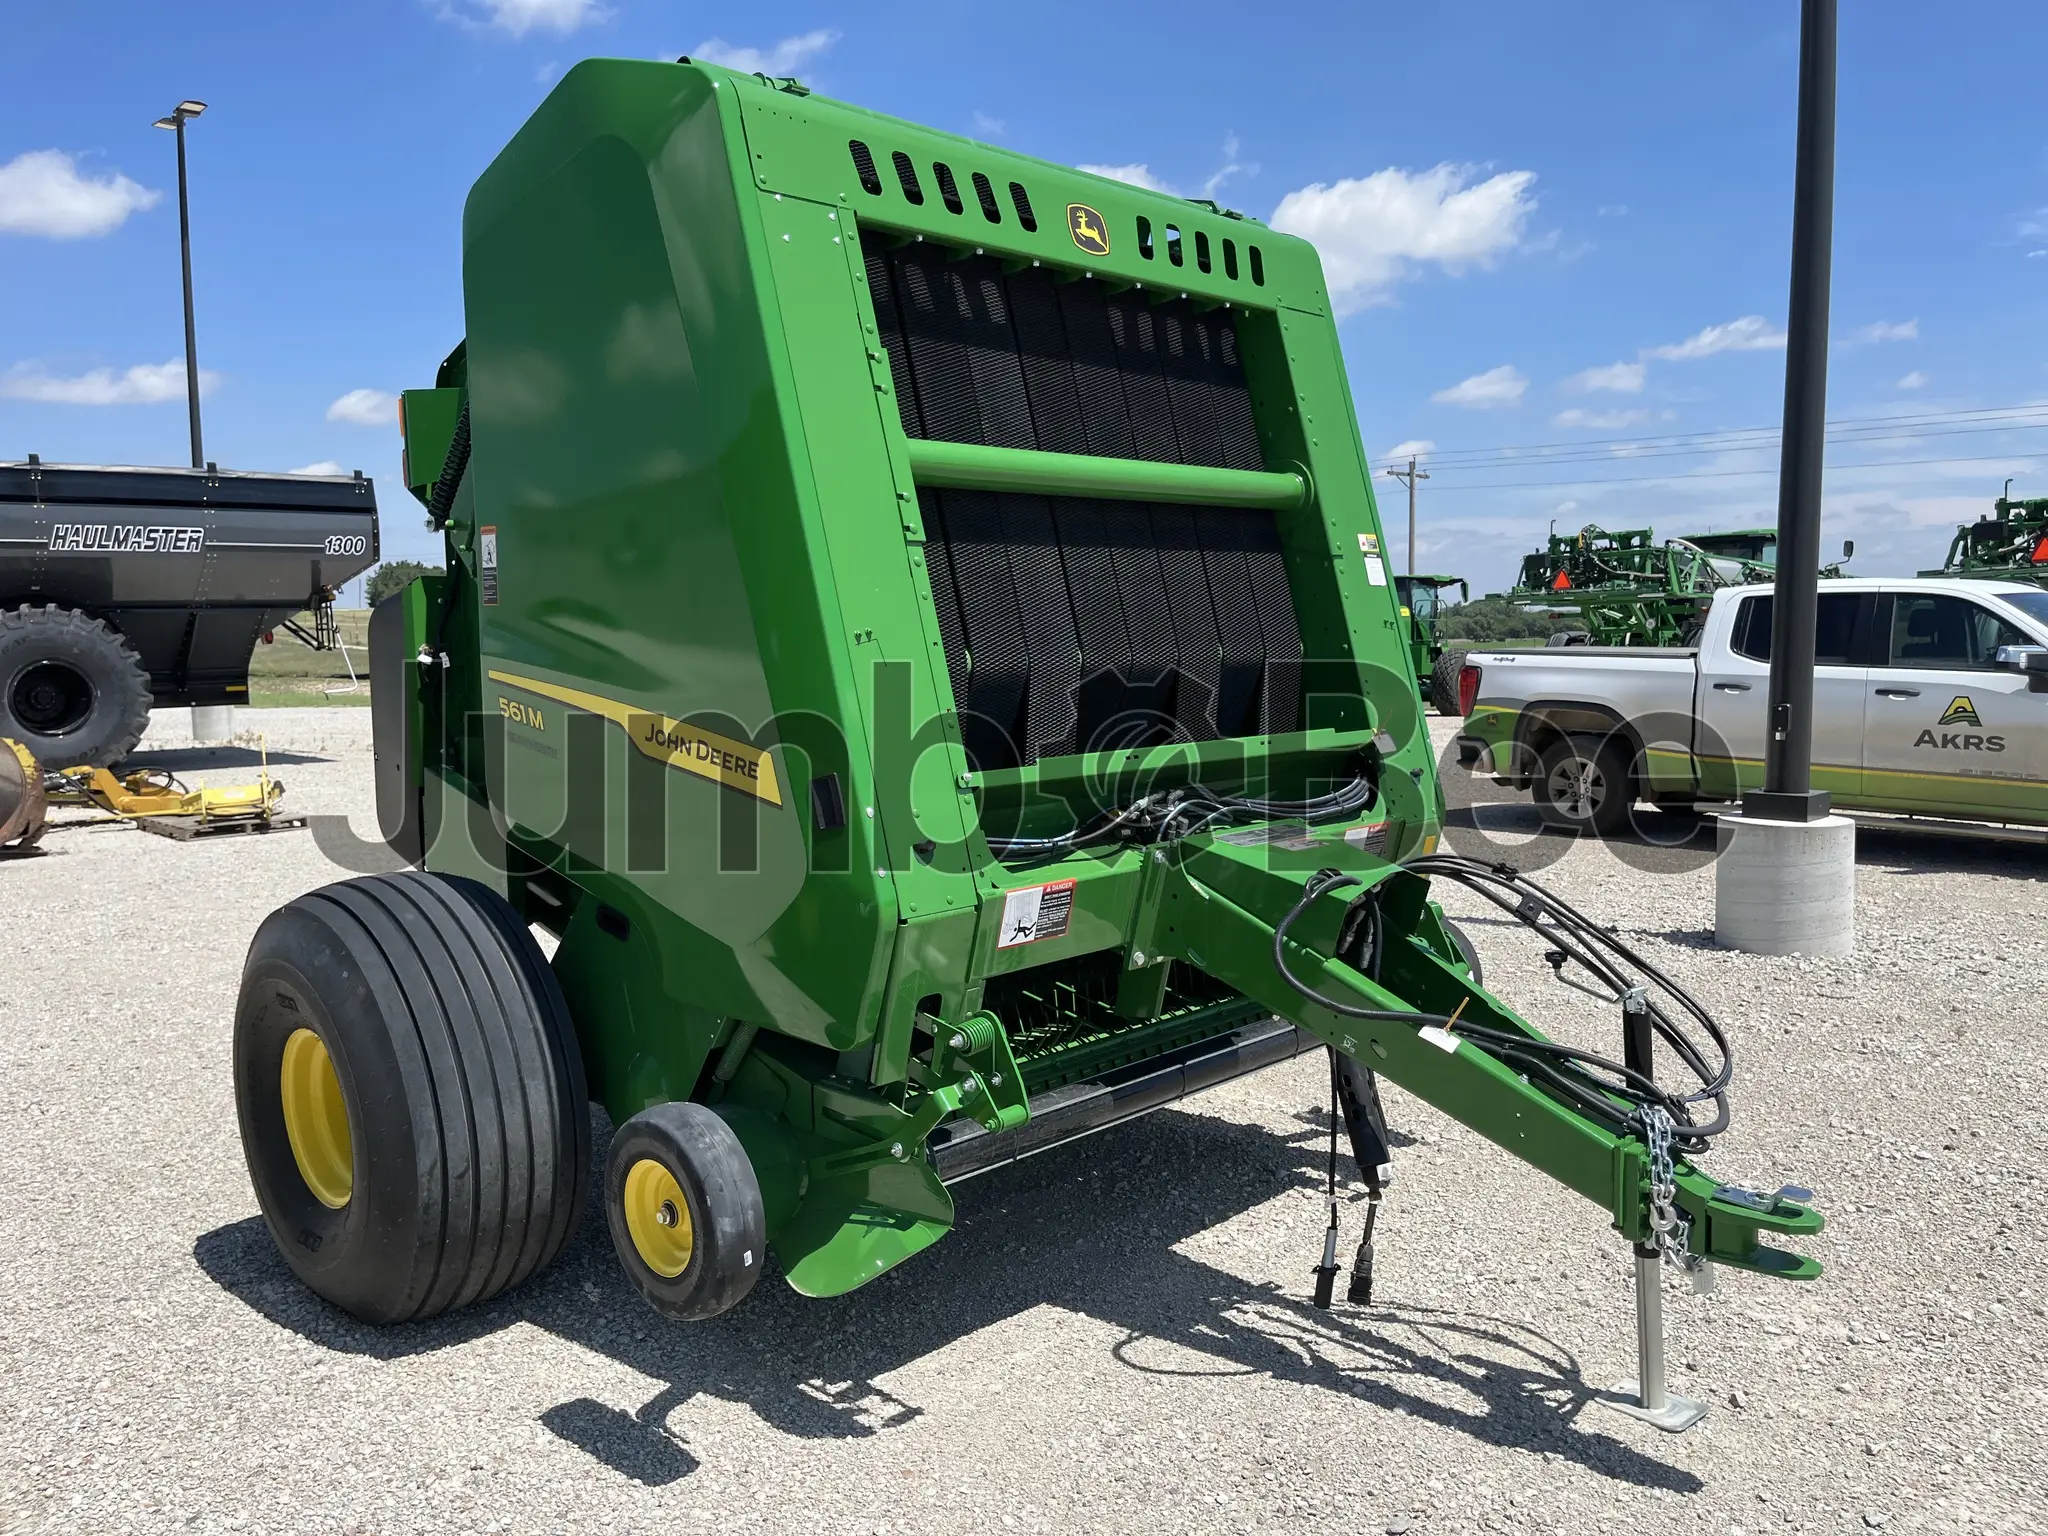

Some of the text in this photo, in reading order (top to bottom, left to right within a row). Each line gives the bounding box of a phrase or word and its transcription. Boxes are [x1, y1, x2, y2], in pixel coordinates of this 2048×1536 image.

[50, 524, 204, 552] HAULMASTER
[325, 535, 366, 556] 1300
[1051, 881, 1073, 892] DANGER
